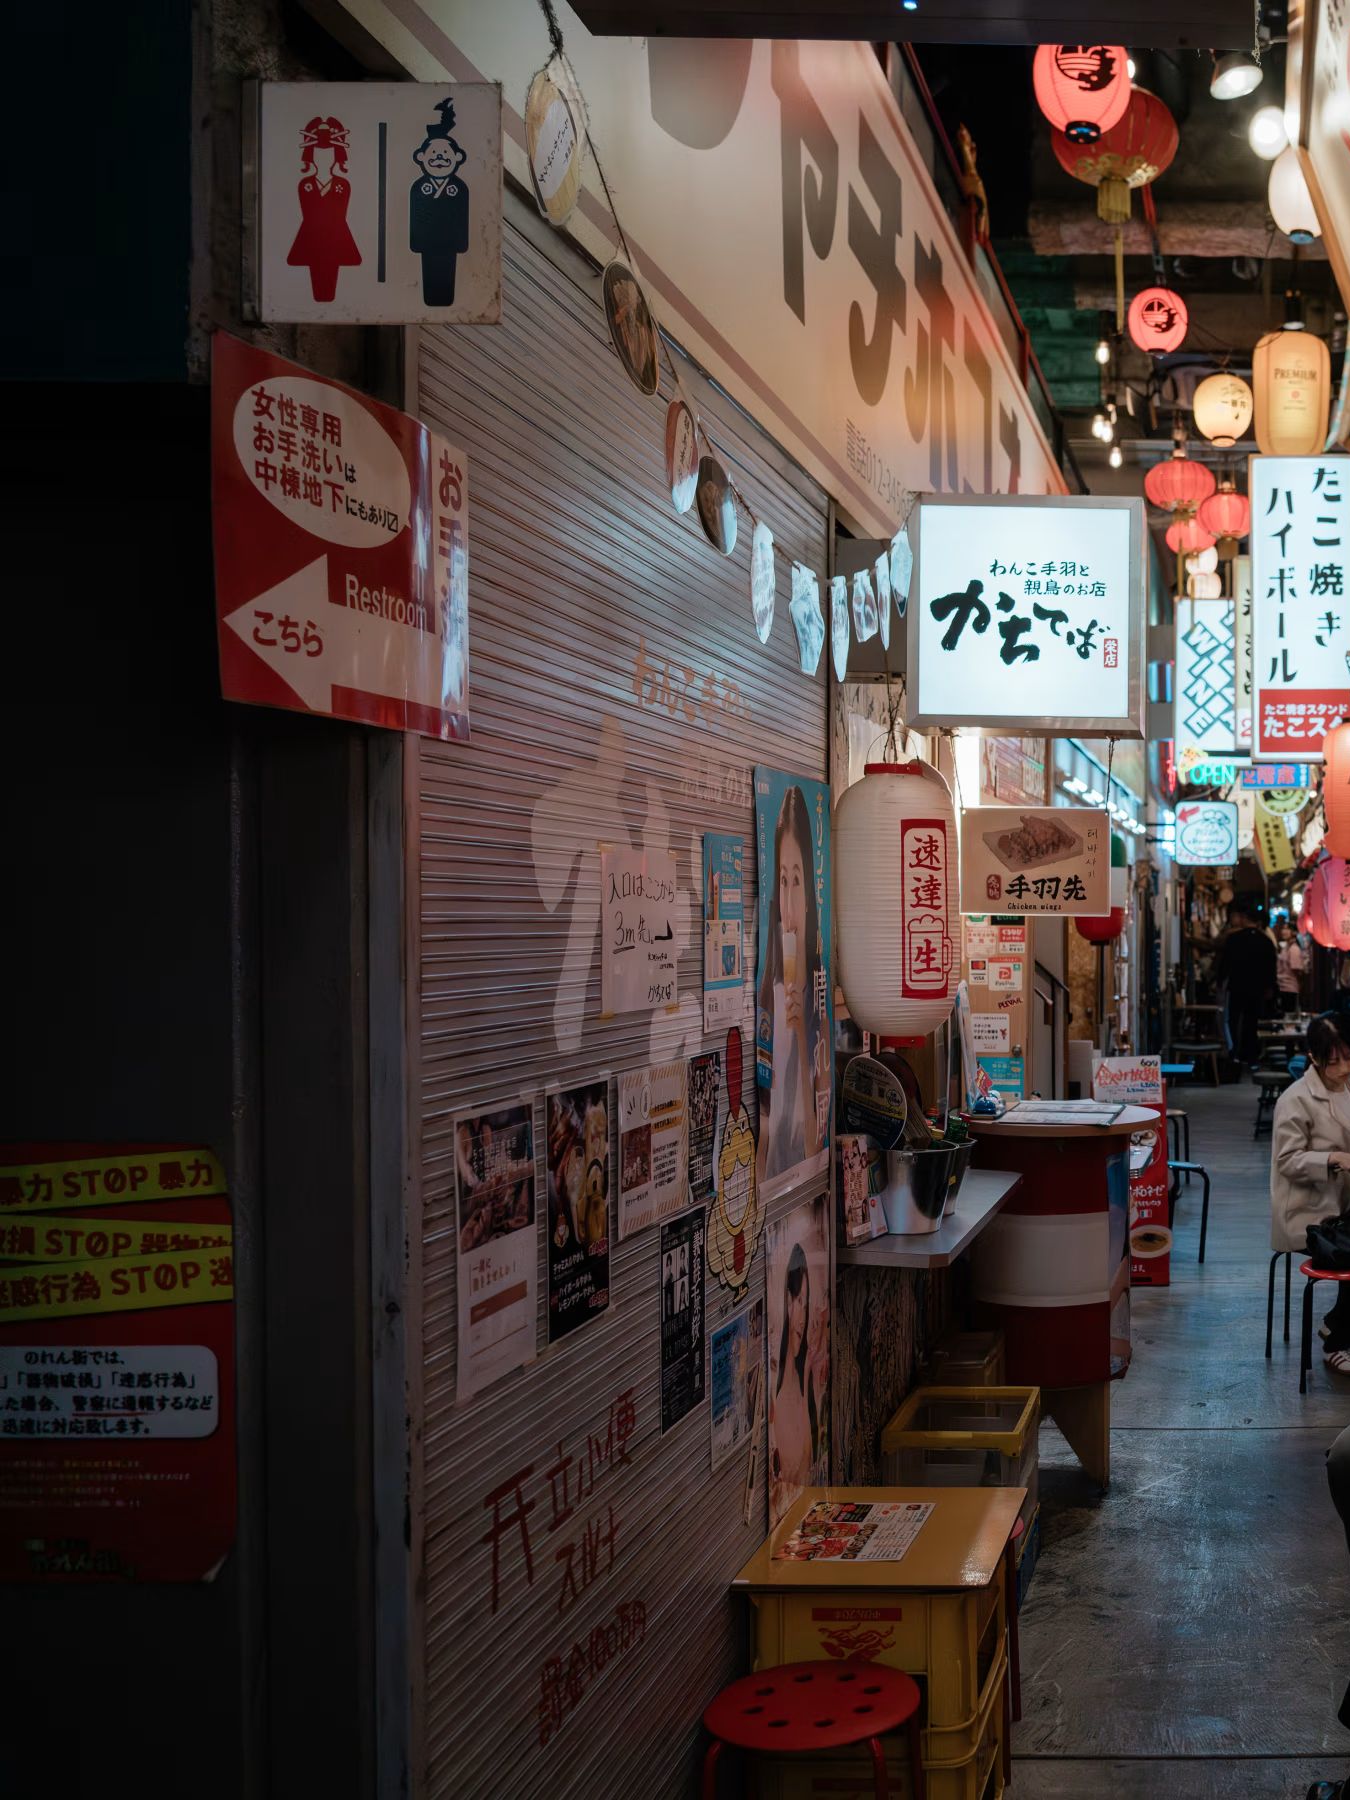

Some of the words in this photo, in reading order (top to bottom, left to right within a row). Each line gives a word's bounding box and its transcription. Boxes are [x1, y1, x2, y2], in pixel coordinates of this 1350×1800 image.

[1274, 369, 1317, 381] PREMIUM
[251, 386, 342, 447] 女性専用
[253, 421, 356, 484] お手洗いは
[989, 558, 1090, 578] わんこ手羽と
[1309, 467, 1345, 648] たこ焼き
[345, 574, 428, 631] Restroom
[1023, 579, 1108, 598] 親鳥のお店
[1266, 487, 1298, 684] ハイボール
[253, 610, 324, 659] こちら
[930, 580, 1111, 666] かちてば
[1182, 621, 1223, 740] WINE
[1190, 765, 1235, 787] OPEN
[608, 871, 675, 904] 入口はここから
[909, 834, 943, 910] 速達
[1005, 874, 1088, 901] 手羽先
[1007, 902, 1037, 910] Chicken
[912, 938, 943, 976] 生
[62, 1166, 148, 1198] STOP
[159, 1159, 213, 1190] 暴力
[45, 1228, 131, 1258] STOP
[110, 1266, 200, 1295] STOP
[25, 1352, 125, 1366] のれん街では、
